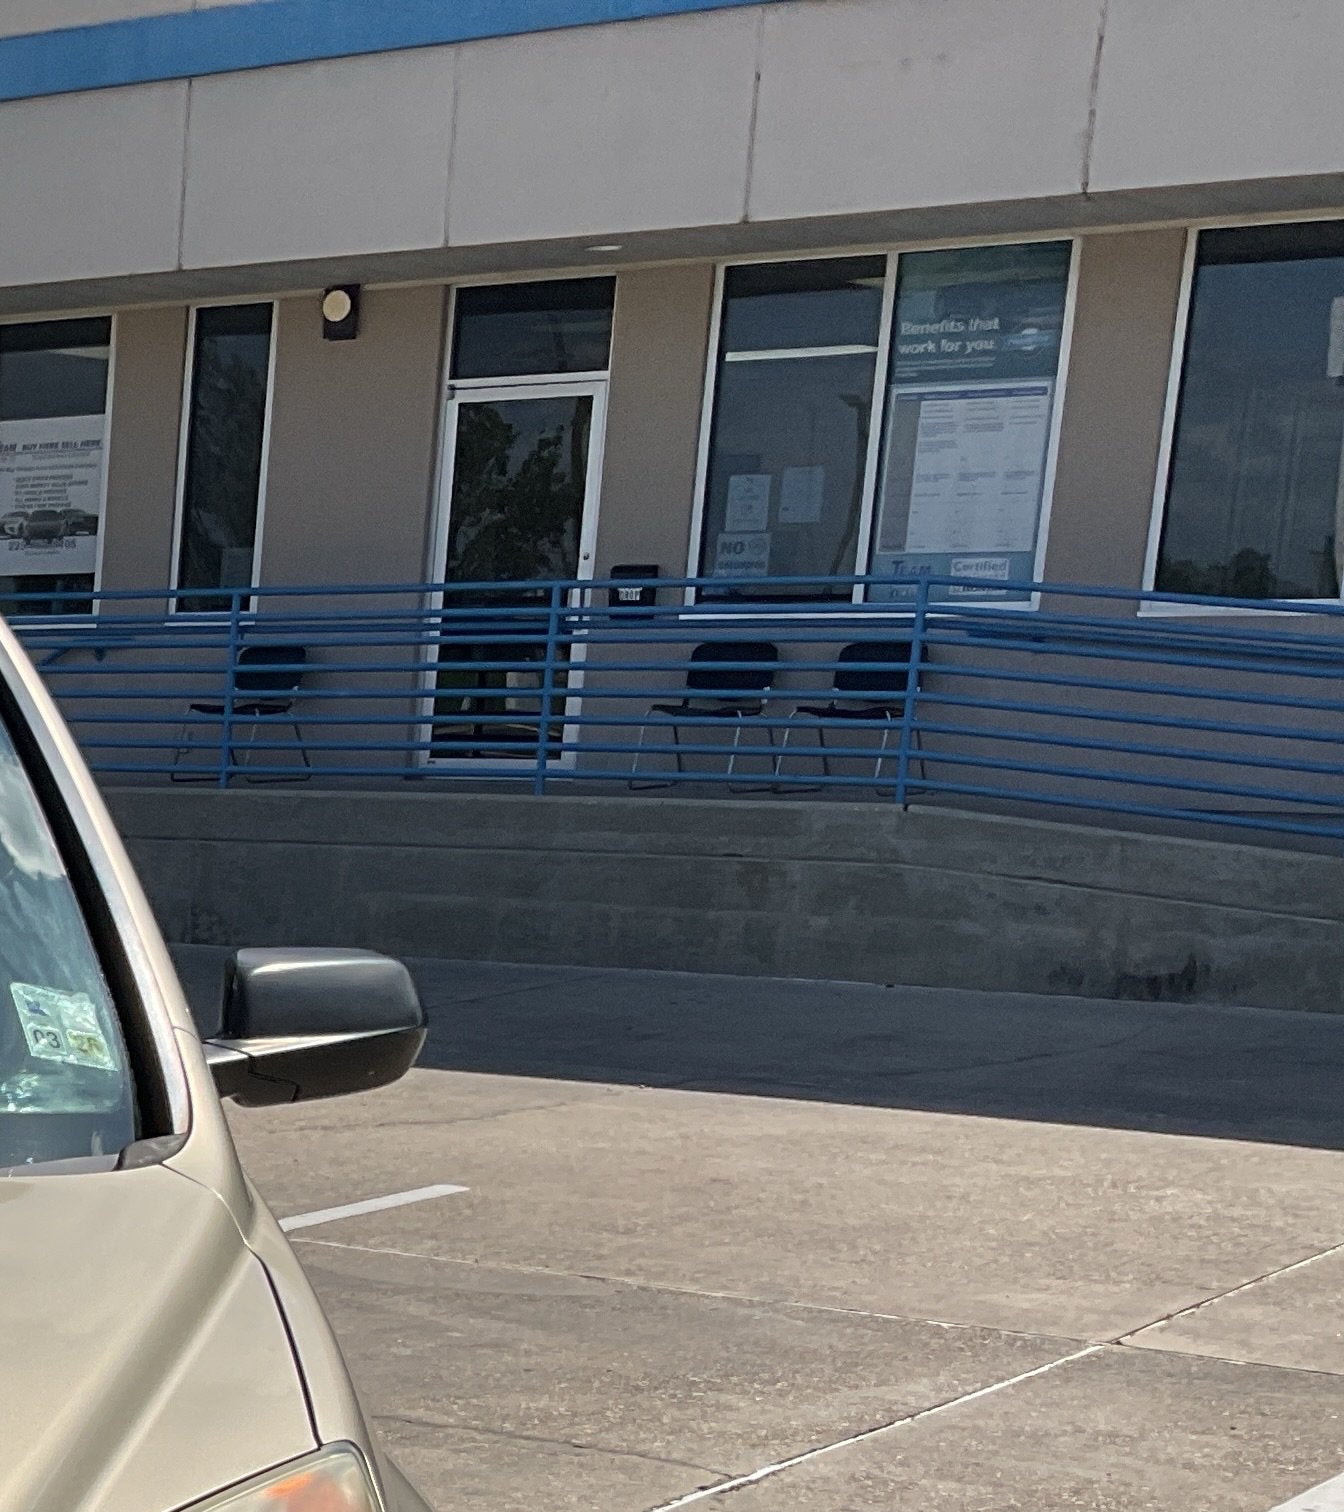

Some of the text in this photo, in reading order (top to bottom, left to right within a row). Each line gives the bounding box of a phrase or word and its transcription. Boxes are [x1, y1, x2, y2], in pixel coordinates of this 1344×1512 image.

[901, 317, 1000, 336] Benefits that
[898, 341, 936, 354] work
[941, 339, 961, 352] for
